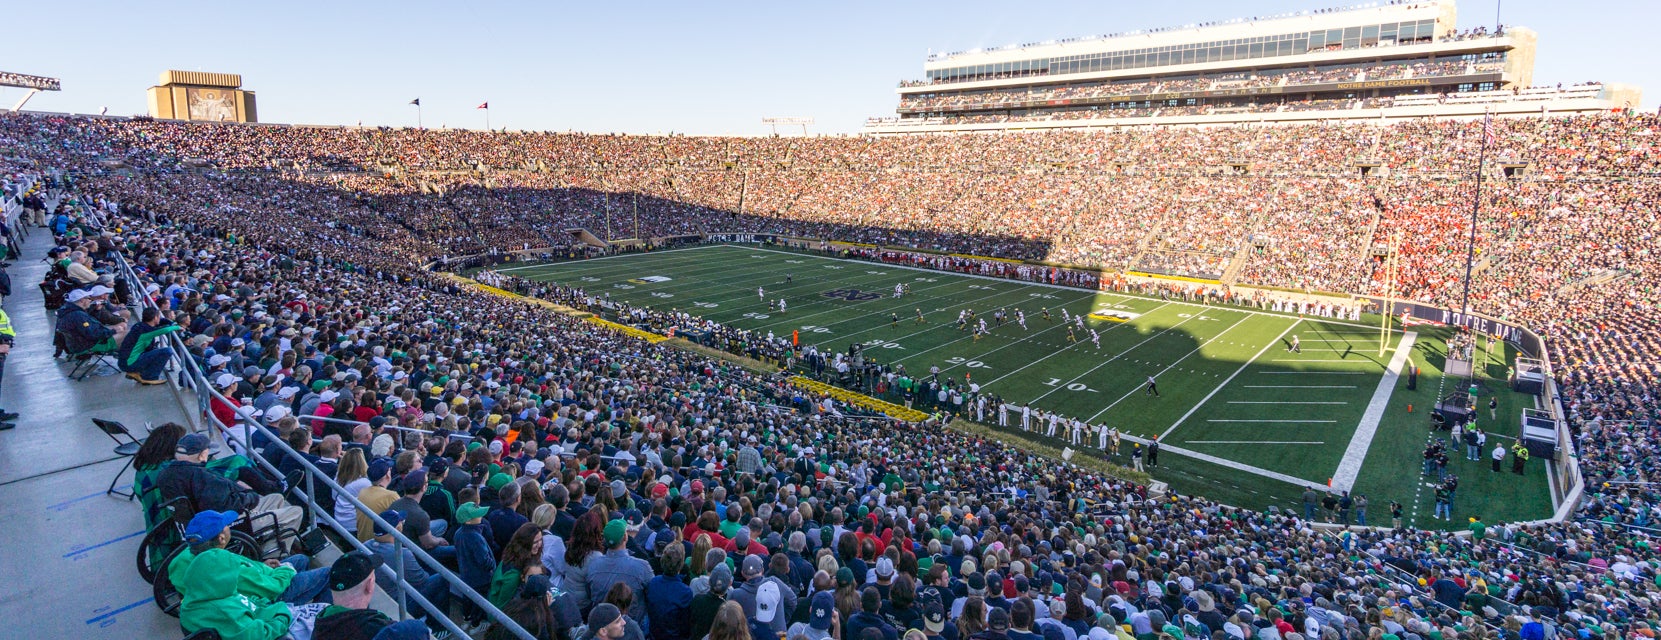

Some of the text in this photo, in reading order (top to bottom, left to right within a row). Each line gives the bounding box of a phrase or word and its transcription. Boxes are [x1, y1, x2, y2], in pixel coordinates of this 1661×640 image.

[1388, 79, 1431, 87] FOOTBALL
[1442, 310, 1523, 343] NOTRE DAME
[945, 357, 985, 368] 20
[1042, 377, 1088, 391] 10
